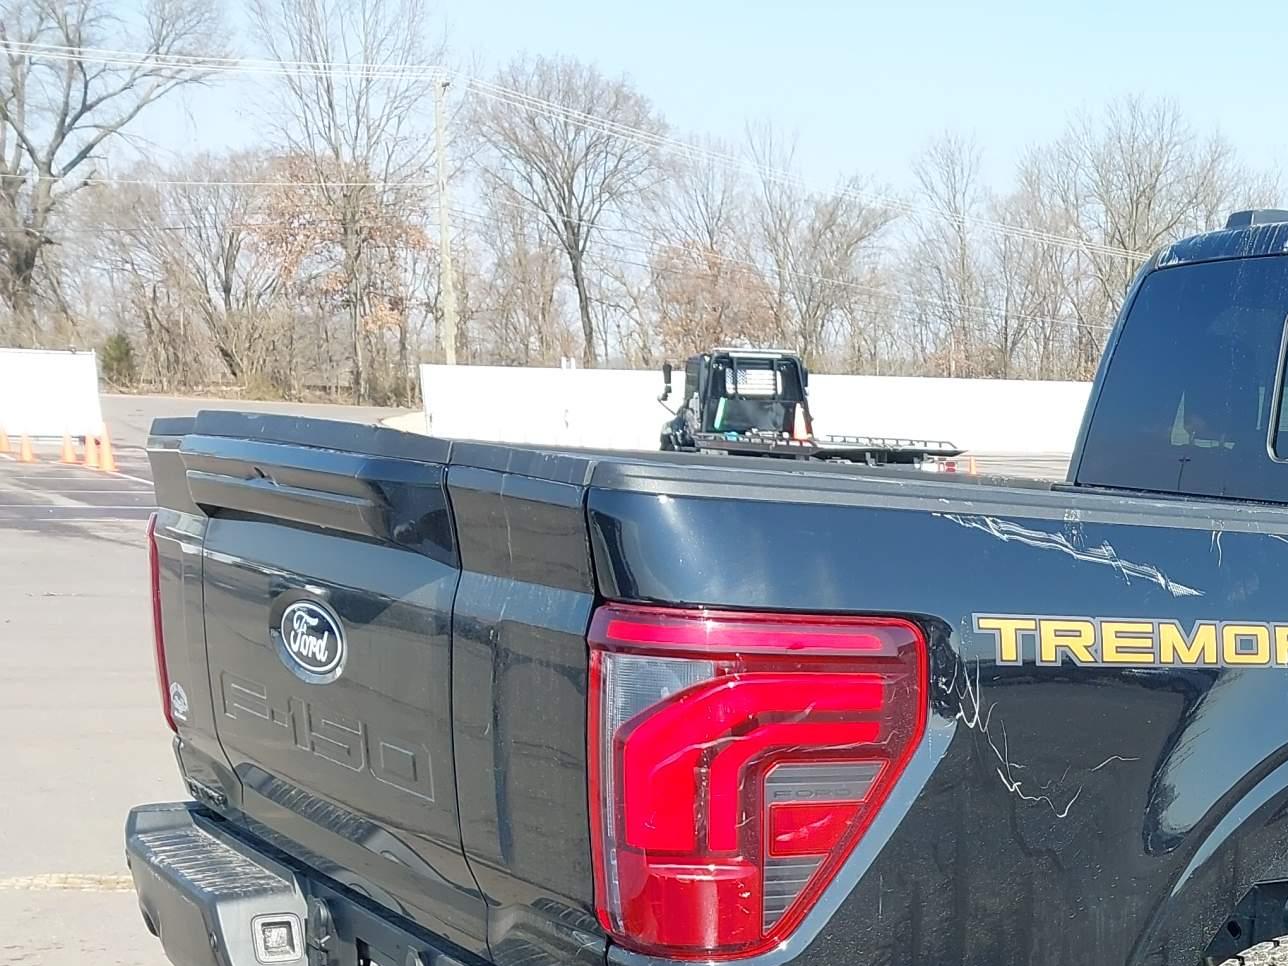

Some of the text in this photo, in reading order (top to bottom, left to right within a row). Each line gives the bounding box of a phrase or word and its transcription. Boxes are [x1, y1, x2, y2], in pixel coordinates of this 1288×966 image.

[289, 610, 329, 662] Ford
[221, 671, 435, 802] F-150
[773, 788, 851, 799] FORD
